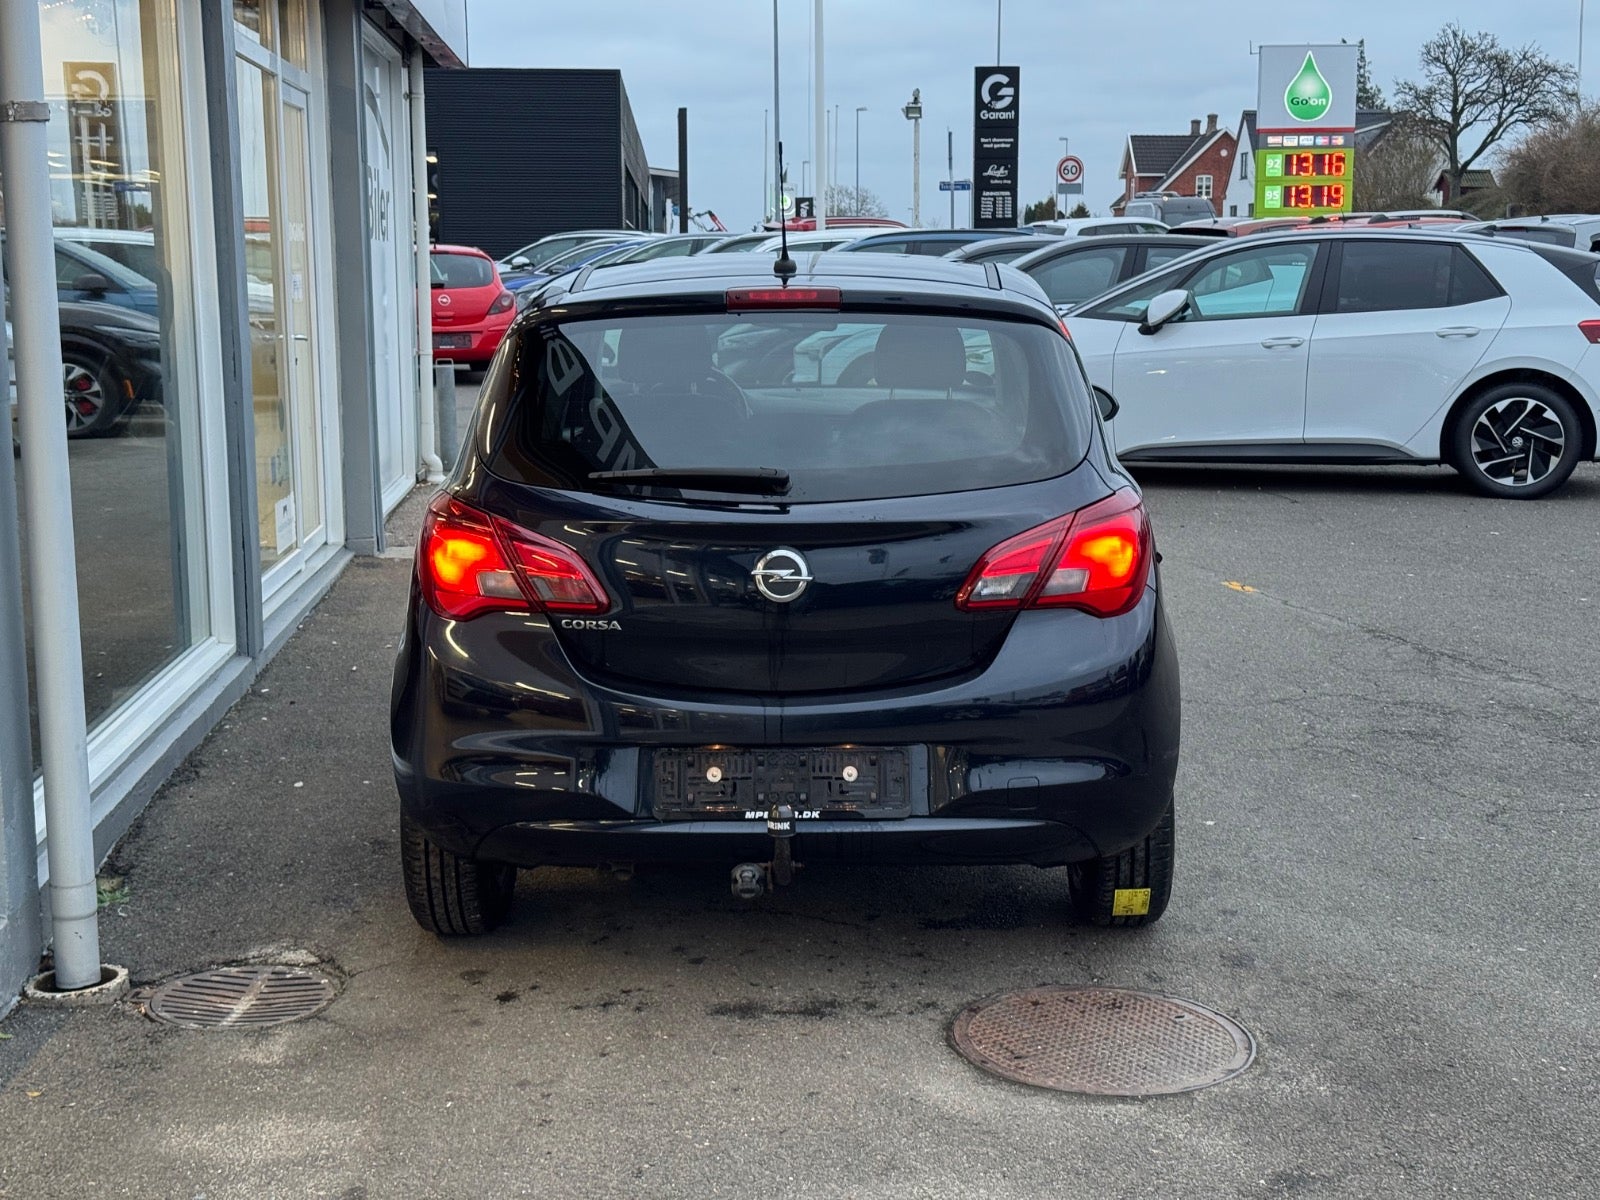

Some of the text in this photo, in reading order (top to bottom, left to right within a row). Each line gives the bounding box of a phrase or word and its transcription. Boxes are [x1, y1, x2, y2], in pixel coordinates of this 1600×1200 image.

[1290, 96, 1326, 106] Go'on
[980, 110, 1015, 120] Garant
[1266, 159, 1280, 168] 92
[1291, 152, 1345, 176] 13.16
[1062, 164, 1078, 176] 60
[1265, 190, 1279, 200] 95
[1290, 184, 1344, 208] 13.19
[560, 618, 622, 631] CORSA
